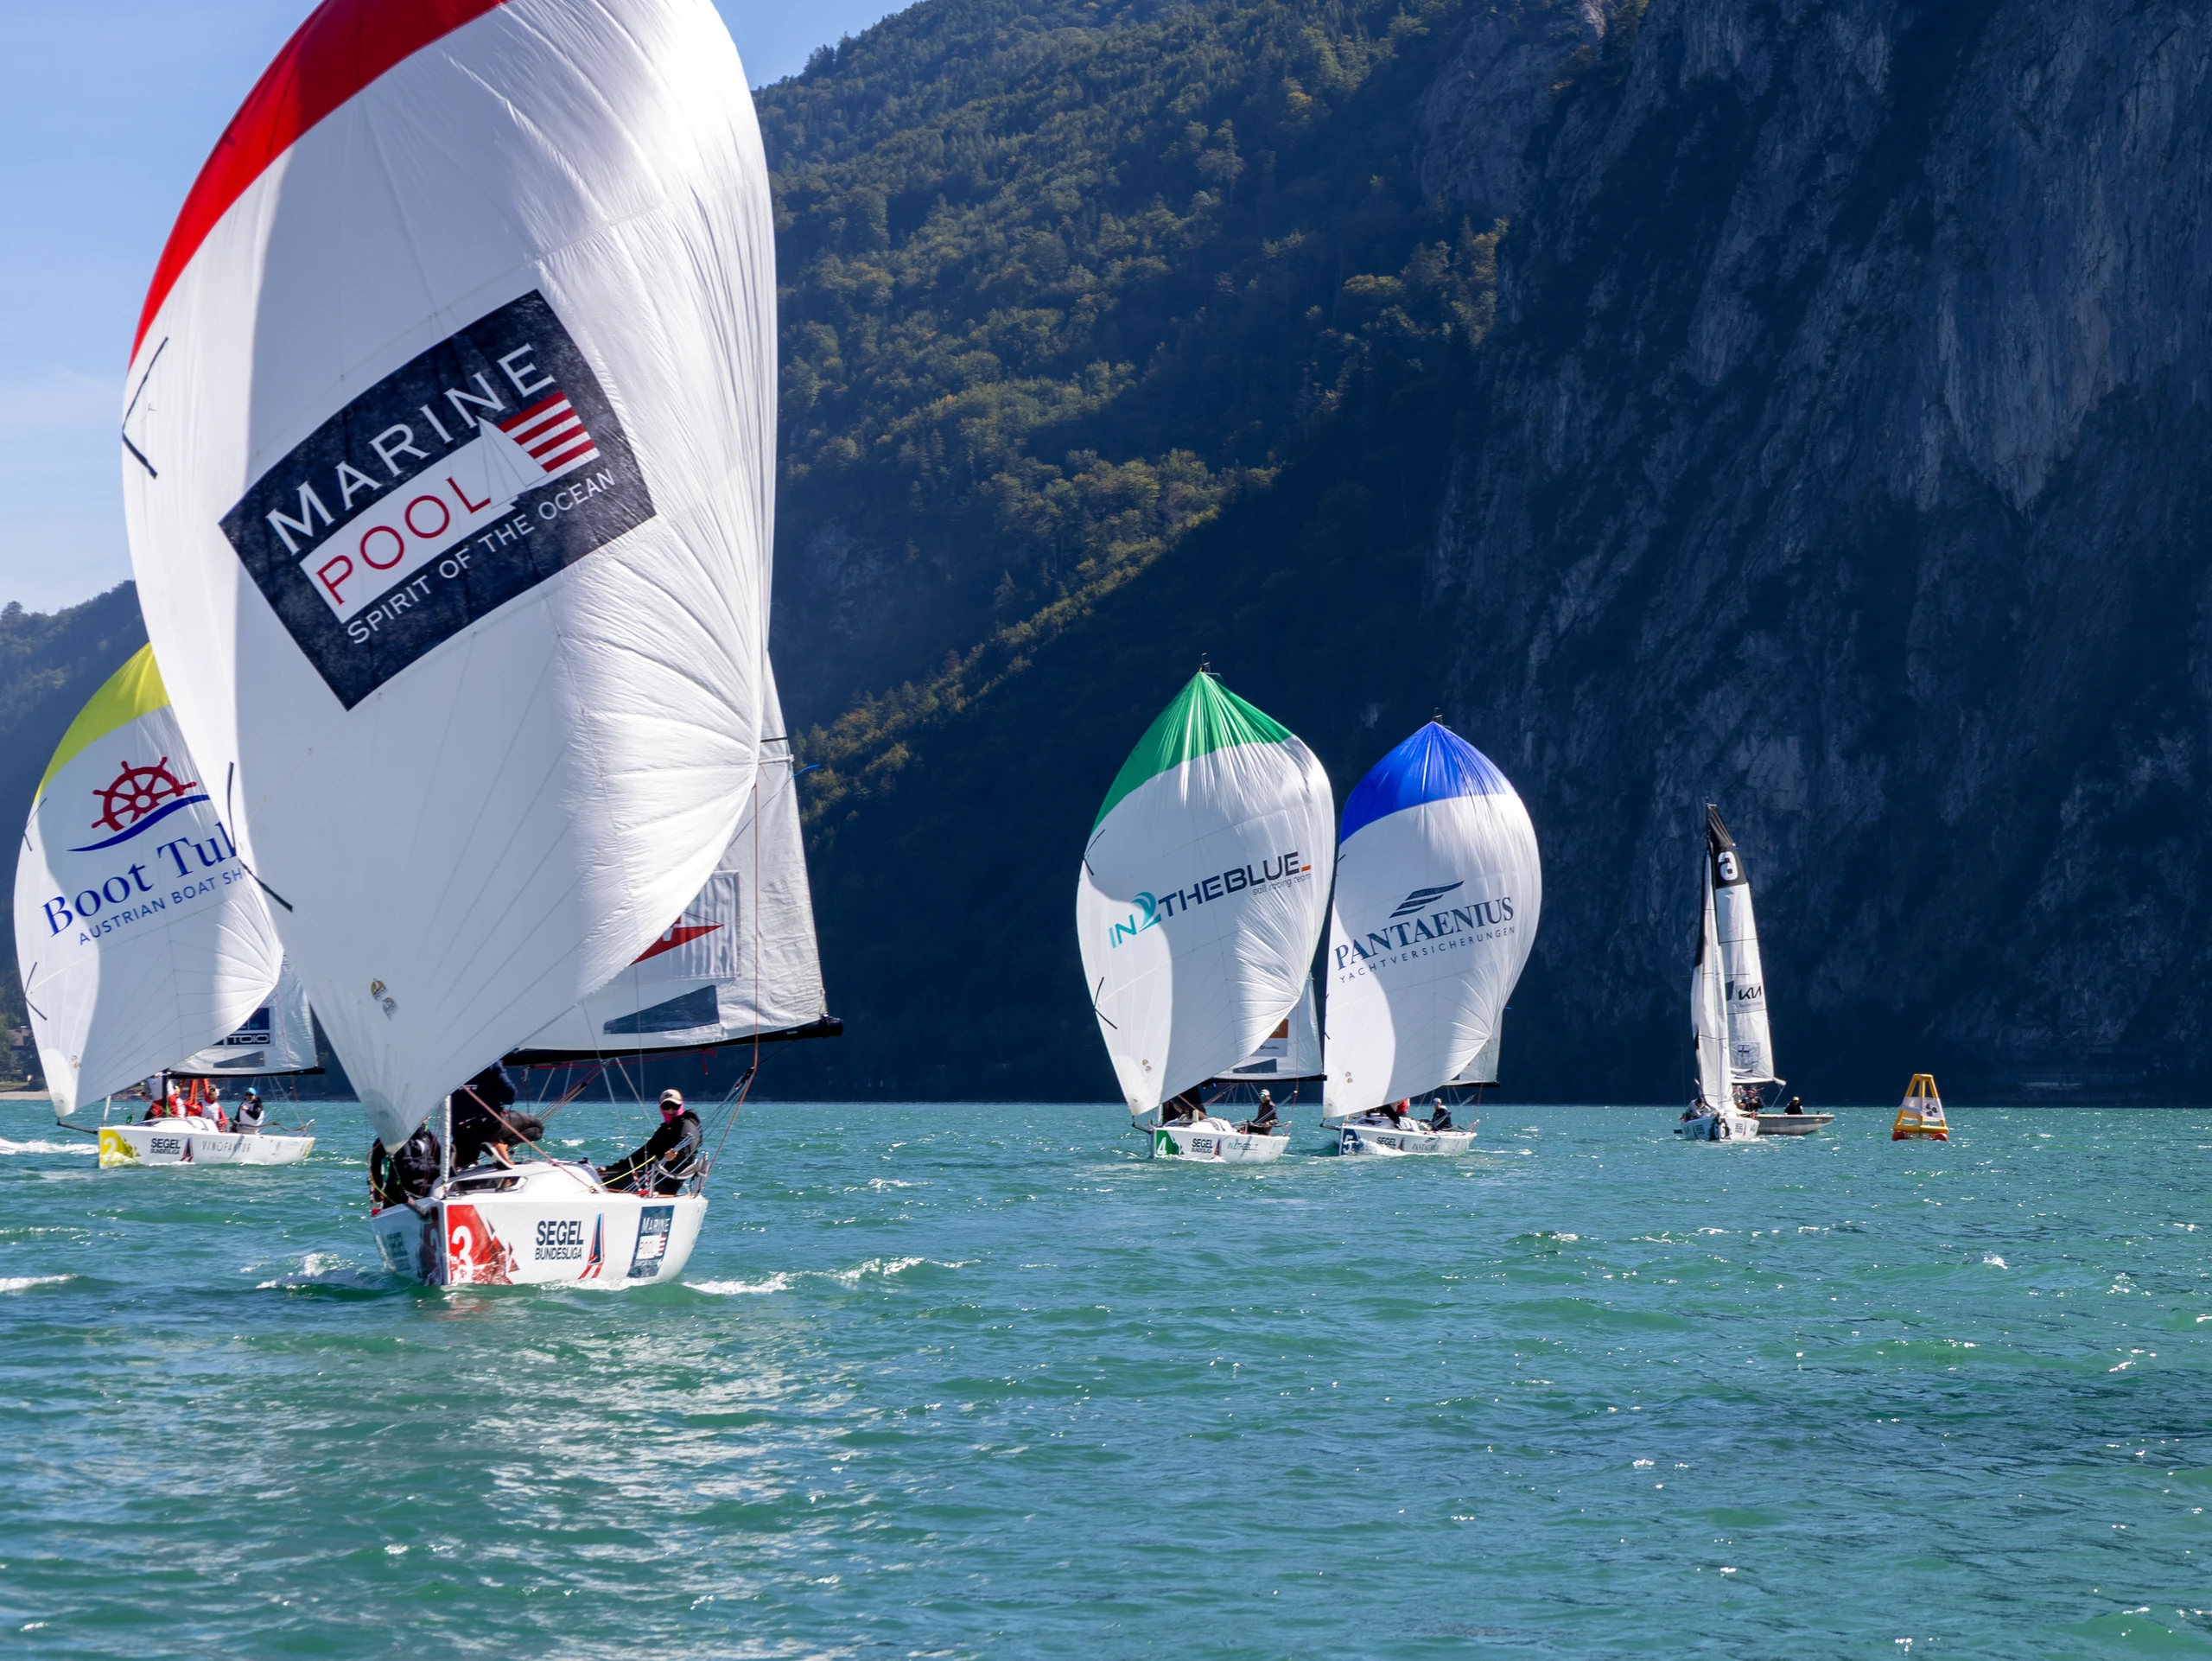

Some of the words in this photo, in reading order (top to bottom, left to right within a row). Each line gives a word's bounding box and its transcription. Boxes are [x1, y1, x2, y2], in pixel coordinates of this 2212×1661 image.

[265, 342, 556, 556] MARINE
[316, 476, 491, 606] POOL
[346, 574, 432, 645] SPIRIT
[438, 547, 472, 579] OF
[477, 513, 536, 553] THE
[537, 468, 616, 520] OCEAN
[1252, 883, 1268, 895] sail
[1268, 877, 1293, 891] racing
[40, 862, 154, 938] Boot
[79, 897, 167, 946] AUSTRIAN
[170, 876, 216, 905] BOAT
[221, 867, 244, 886] SH
[1334, 895, 1514, 971] PANTAENIUS
[1339, 926, 1516, 983] YACHTVERSICHERUNGEN
[103, 1136, 117, 1161] 2
[150, 1137, 181, 1149] SEGEL
[1156, 1136, 1167, 1157] 4
[1192, 1137, 1213, 1149] SEGEL
[1343, 1135, 1354, 1155] 5
[1376, 1136, 1397, 1147] SEGEL
[536, 1220, 584, 1246] SEGEL
[640, 1217, 671, 1234] MARINE
[451, 1225, 474, 1282] 3
[535, 1247, 582, 1261] BUNDESLIGA
